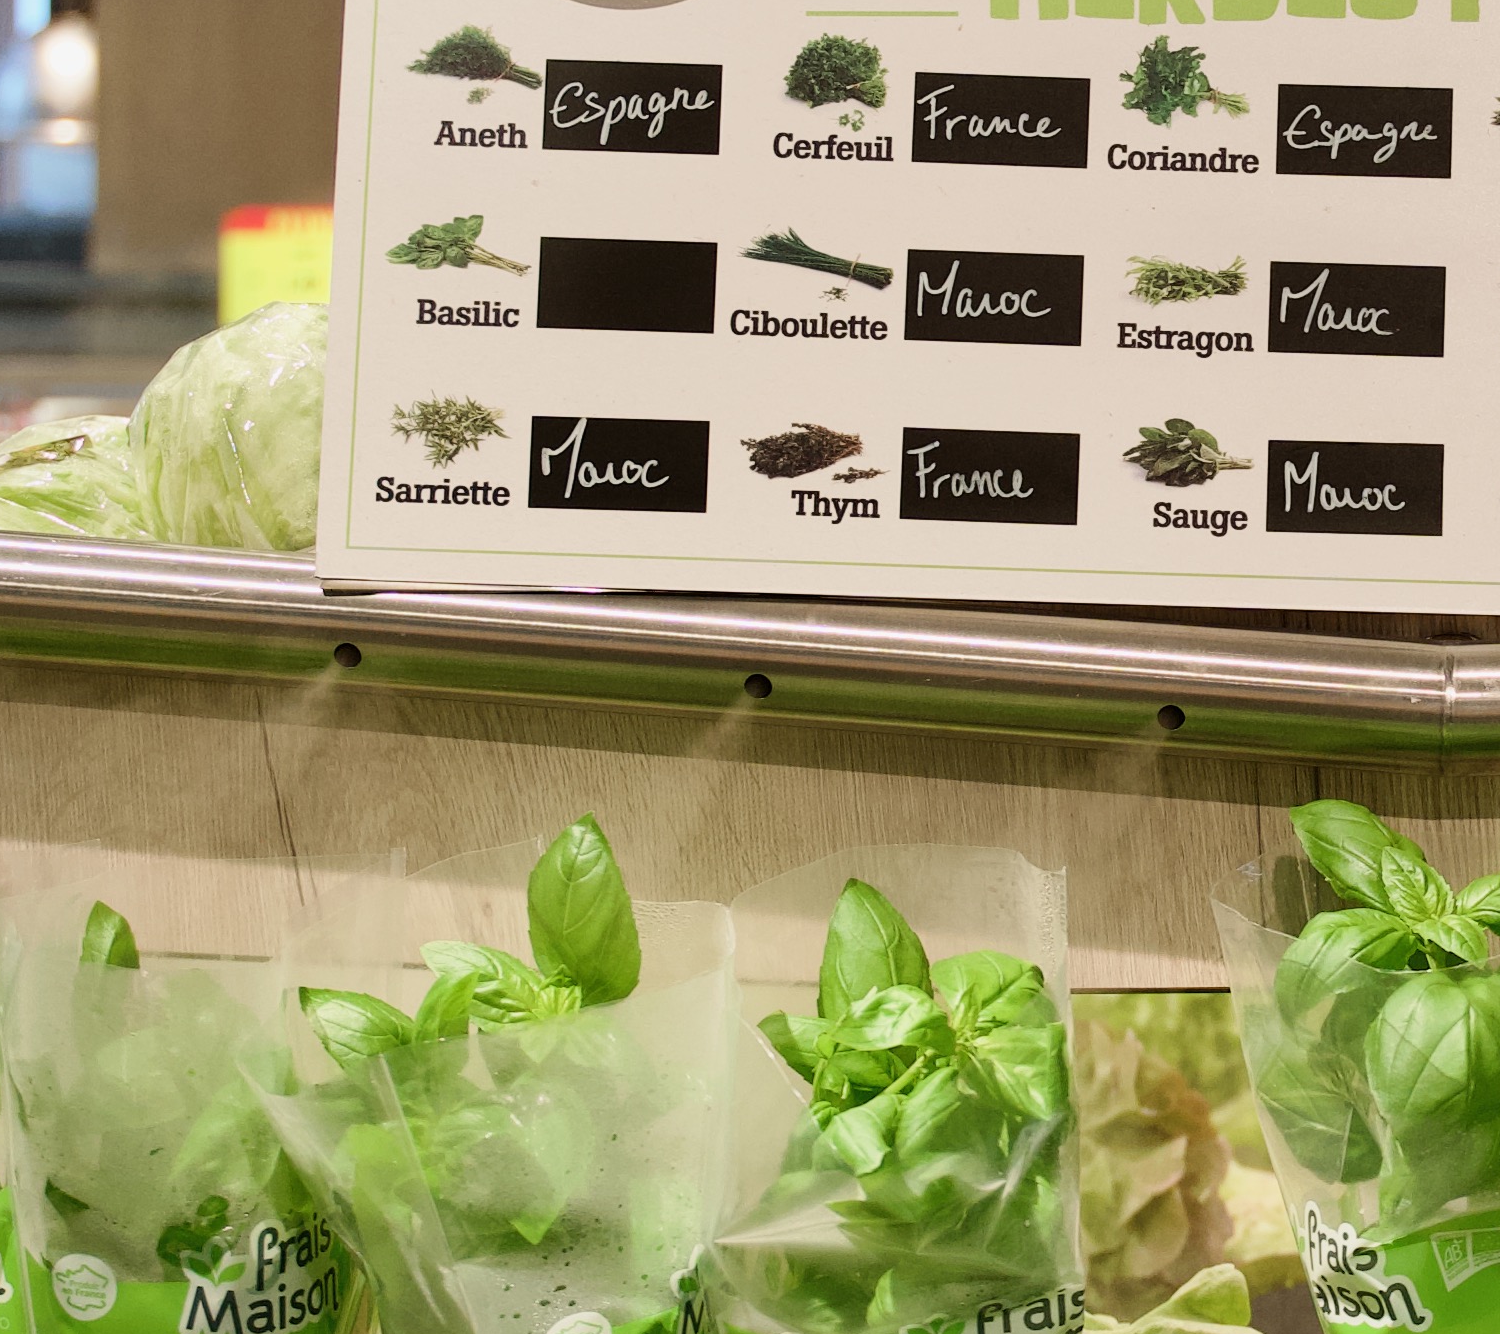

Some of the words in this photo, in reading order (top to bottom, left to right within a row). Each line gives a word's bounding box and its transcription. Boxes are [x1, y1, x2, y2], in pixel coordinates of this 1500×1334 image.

[549, 81, 714, 145] Espagne
[917, 85, 1061, 140] France
[1282, 105, 1437, 163] Espagne
[434, 121, 528, 148] Aneth
[773, 133, 893, 161] Cerfeuil
[1108, 144, 1259, 173] Coriandre
[917, 260, 1051, 318] Maroc
[1280, 268, 1394, 335] Maroc
[416, 299, 519, 328] Basilic
[730, 309, 888, 339] Ciboulette
[1117, 323, 1255, 358] Estragon
[541, 418, 669, 498] Maroc
[907, 441, 1034, 499] France
[376, 476, 510, 506] Sarriette
[1284, 451, 1406, 513] Maroc
[791, 490, 880, 524] Thym
[1153, 502, 1248, 537] Sauge
[1315, 1275, 1426, 1326] aison
